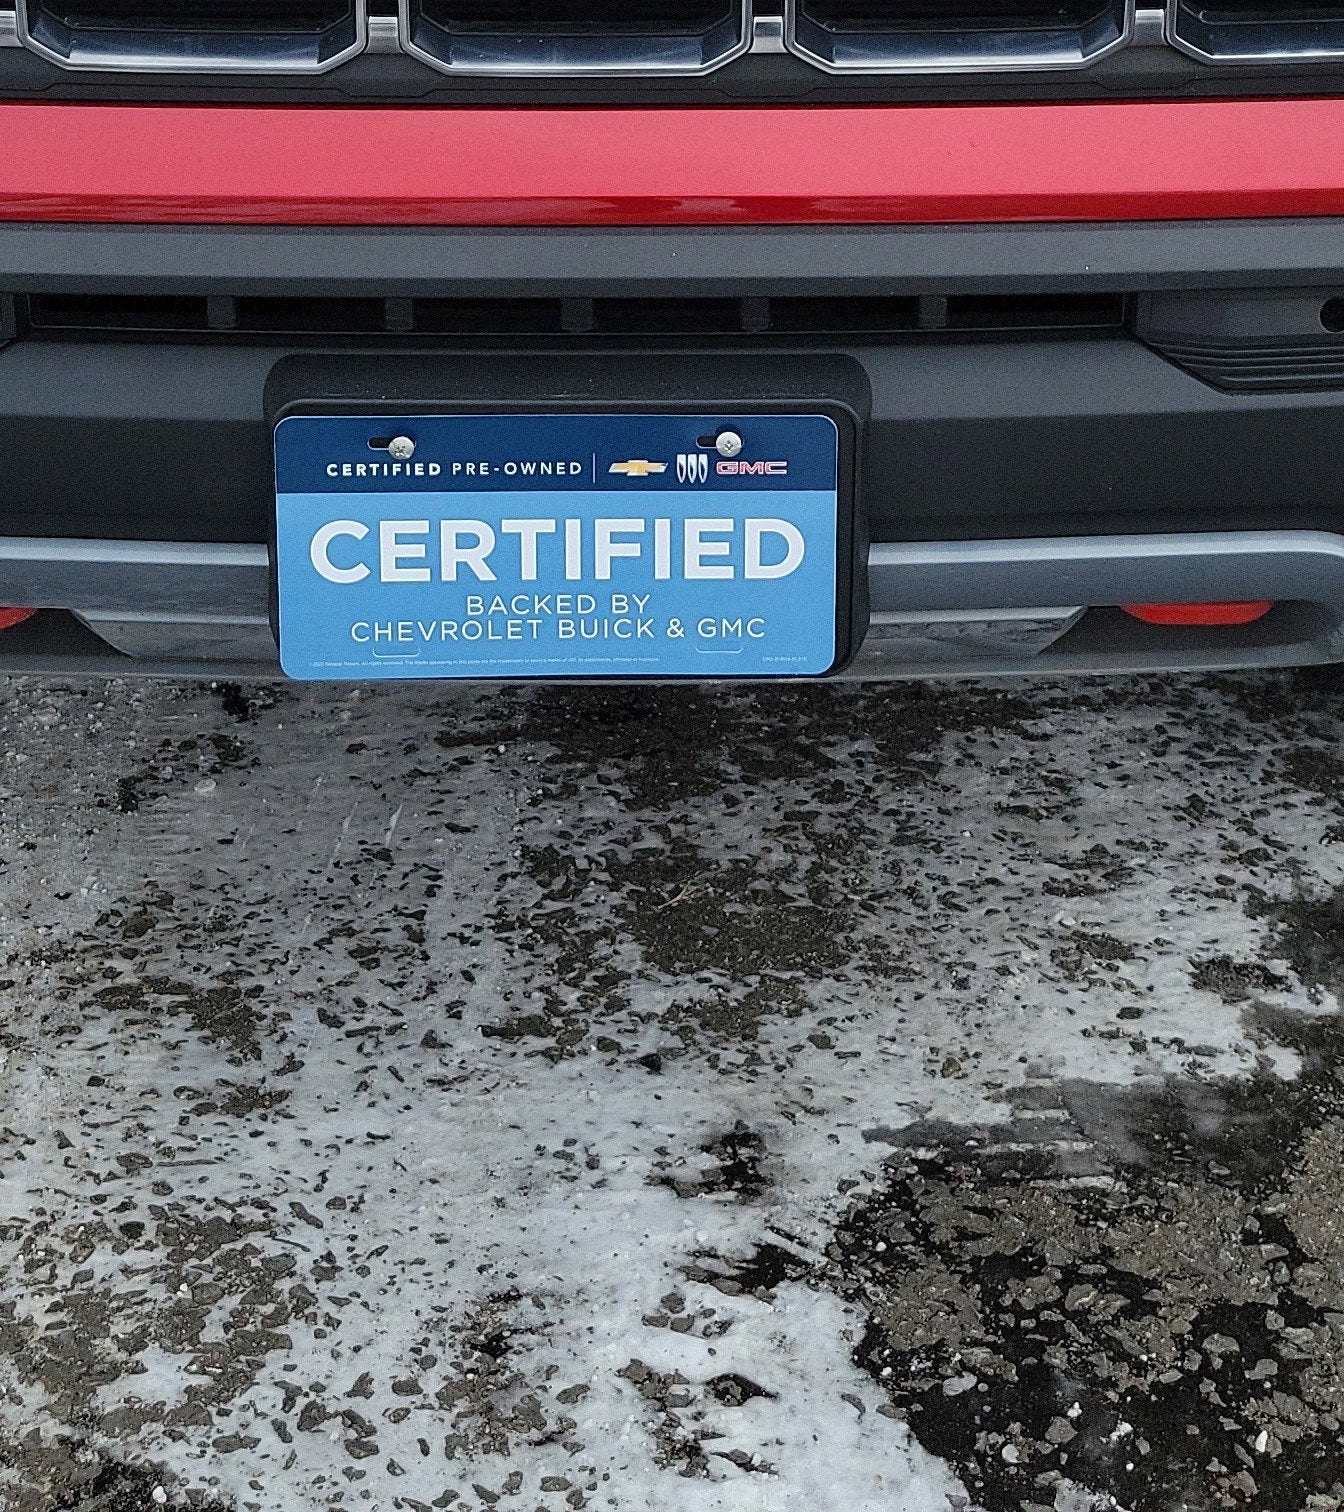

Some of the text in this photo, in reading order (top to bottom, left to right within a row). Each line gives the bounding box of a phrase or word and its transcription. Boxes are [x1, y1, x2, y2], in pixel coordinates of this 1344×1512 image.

[326, 462, 582, 477] CERTIFIED PRE-OWNED
[716, 460, 788, 475] GMC
[309, 517, 806, 585] CERTIFIED
[466, 593, 651, 616] BACKED BY
[350, 617, 766, 643] CHEVROLET BUICK & GMC
